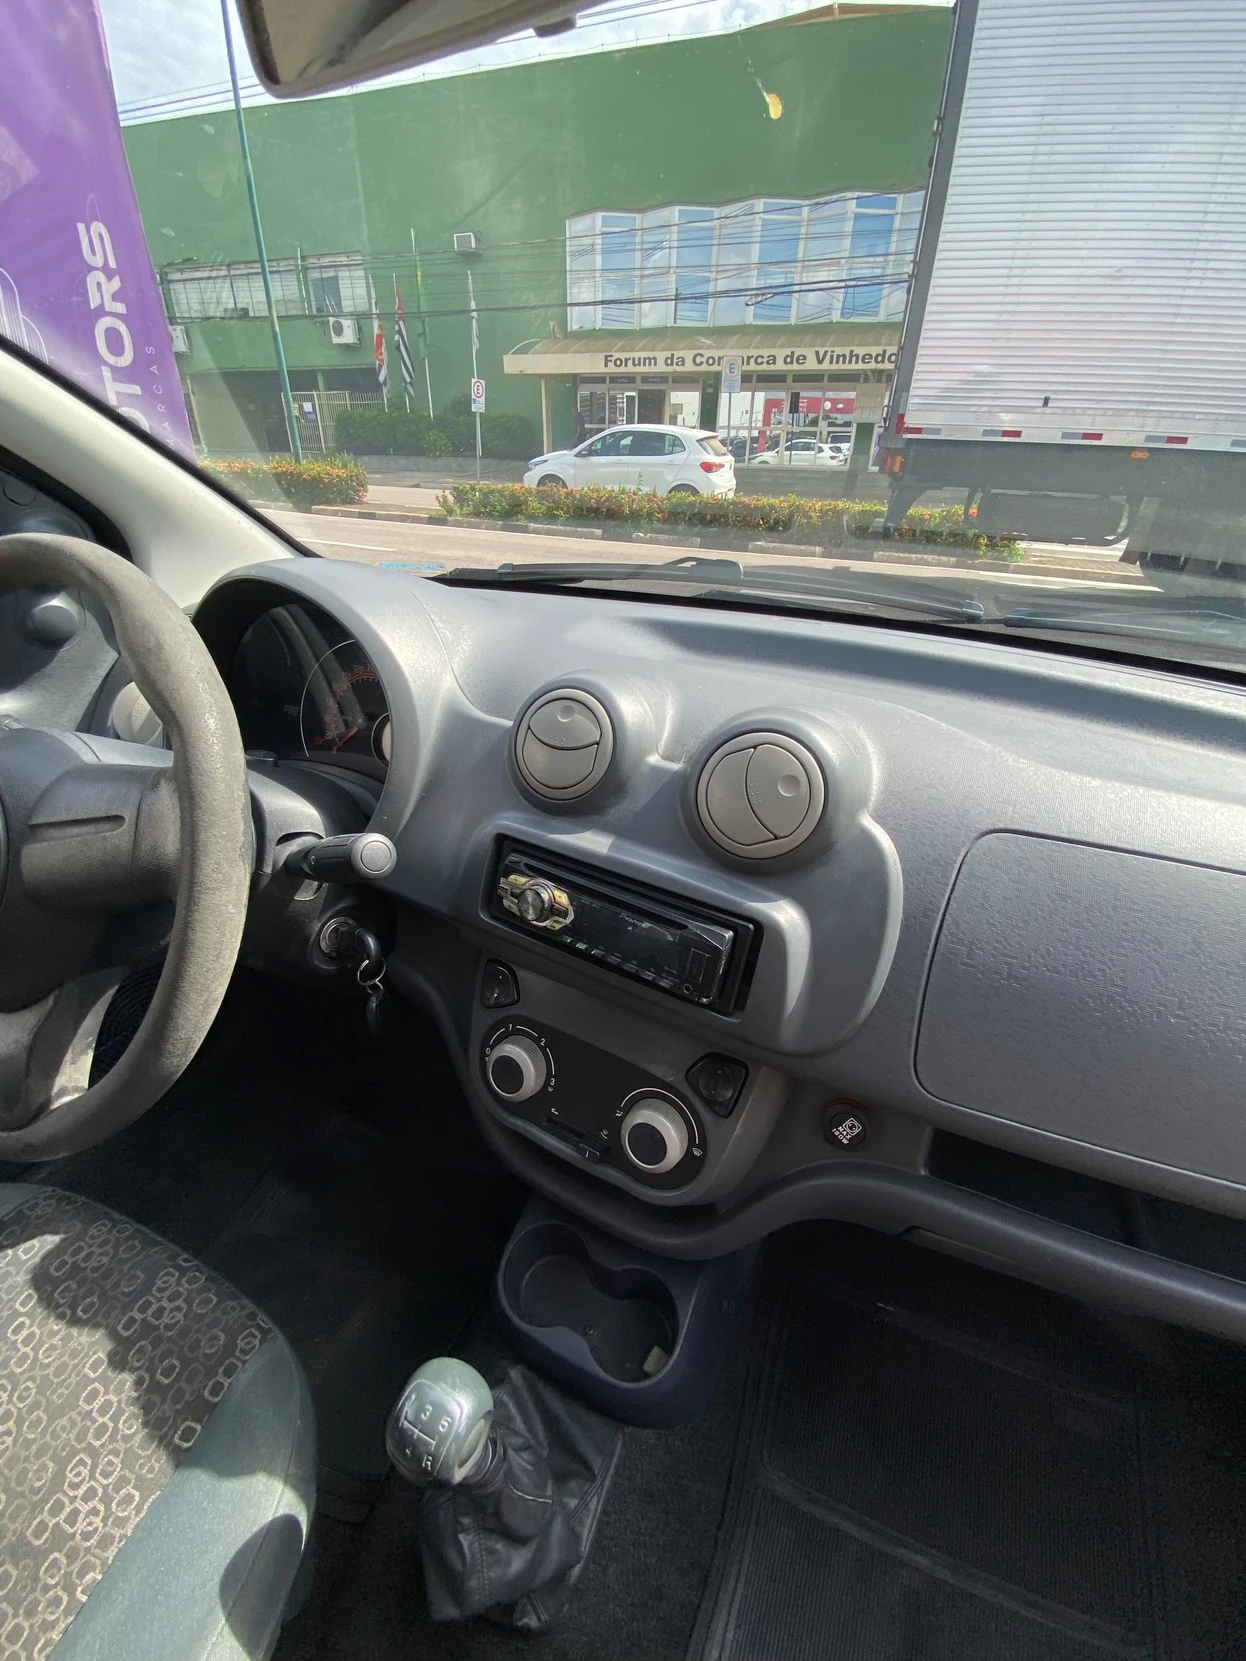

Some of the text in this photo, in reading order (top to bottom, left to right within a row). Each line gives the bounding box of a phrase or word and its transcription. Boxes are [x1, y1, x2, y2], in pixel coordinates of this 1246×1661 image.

[603, 349, 897, 368] Forum da Corca de Vinhedo
[729, 362, 736, 374] E
[476, 384, 481, 395] E
[508, 1023, 513, 1031] 1
[540, 1038, 546, 1046] 2
[485, 1047, 491, 1055] 0
[549, 1077, 556, 1086] 3
[838, 1126, 851, 1139] MAX
[421, 1405, 432, 1420] 3
[422, 1454, 433, 1470] R
